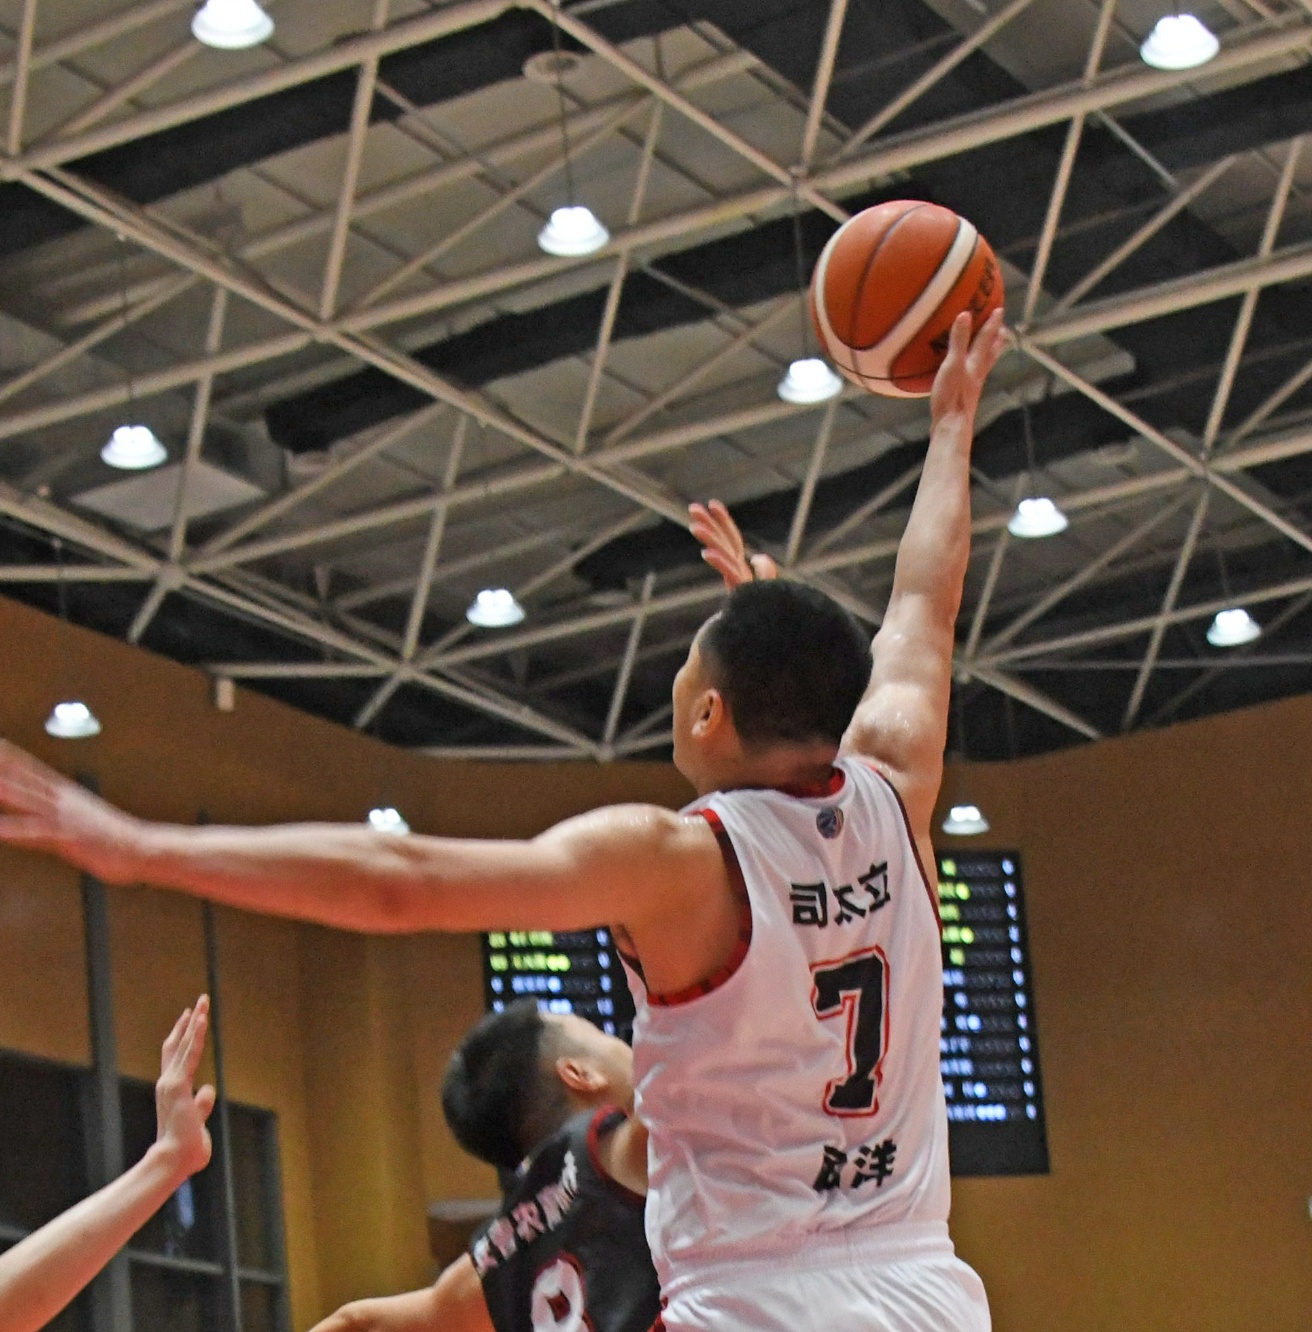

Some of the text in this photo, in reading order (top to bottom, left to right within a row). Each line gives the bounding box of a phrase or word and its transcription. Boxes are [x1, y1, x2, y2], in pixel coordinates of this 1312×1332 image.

[789, 860, 891, 929] 司太立
[811, 947, 889, 1116] 7
